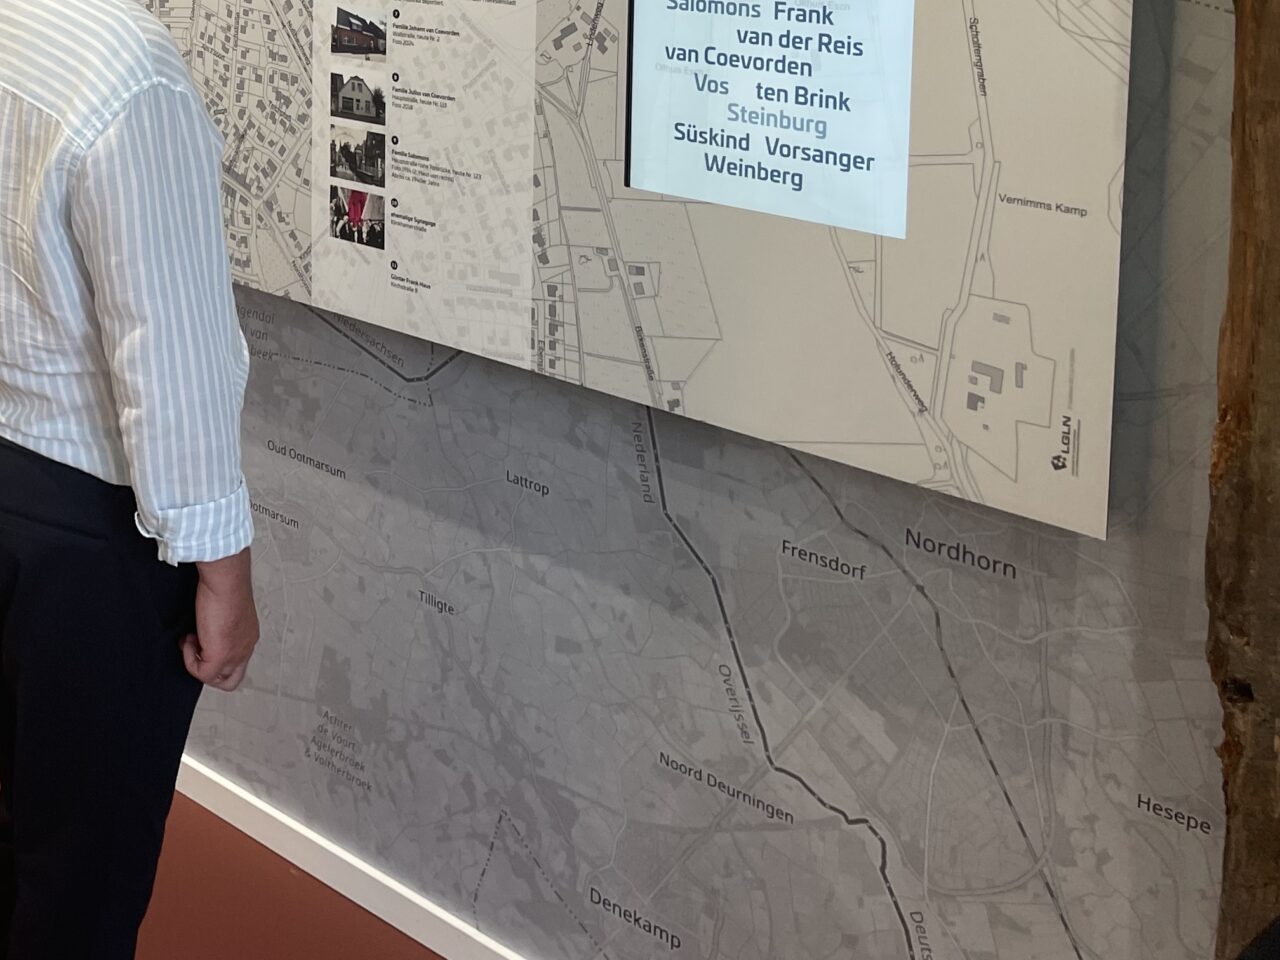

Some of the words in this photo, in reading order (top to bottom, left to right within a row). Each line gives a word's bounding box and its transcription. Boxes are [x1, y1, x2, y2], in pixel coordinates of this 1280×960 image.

[774, 0, 834, 25] Frank
[665, 46, 699, 63] van
[704, 46, 812, 77] Coevorden
[736, 29, 773, 47] van
[778, 30, 813, 50] der
[818, 32, 863, 57] Reis
[694, 72, 729, 95] Vos
[756, 81, 788, 103] ten
[794, 86, 851, 112] Brink
[727, 102, 827, 139] Steinburg
[674, 122, 751, 151] Süskind
[765, 135, 875, 172] Vorsanger
[704, 152, 803, 191] Weinberg
[1056, 203, 1088, 217] Kamp
[249, 345, 275, 361] beek
[250, 328, 268, 341] van
[886, 351, 928, 413] Holunderweg
[1061, 415, 1072, 454] LGLN
[267, 440, 287, 456] Oud
[289, 448, 346, 480] Ootmarsum
[631, 421, 656, 504] Nederland
[505, 469, 550, 499] Lattrop
[781, 538, 868, 581] Frensdorf
[905, 527, 1018, 580] Nordhorn
[419, 590, 455, 616] Tilligte
[323, 710, 352, 731] Achter
[718, 663, 755, 746] Overijssel
[317, 724, 328, 734] de
[658, 751, 703, 785] Noord
[705, 771, 795, 826] Deurningen
[1138, 794, 1211, 834] Hesepe
[589, 886, 682, 951] Denekamp
